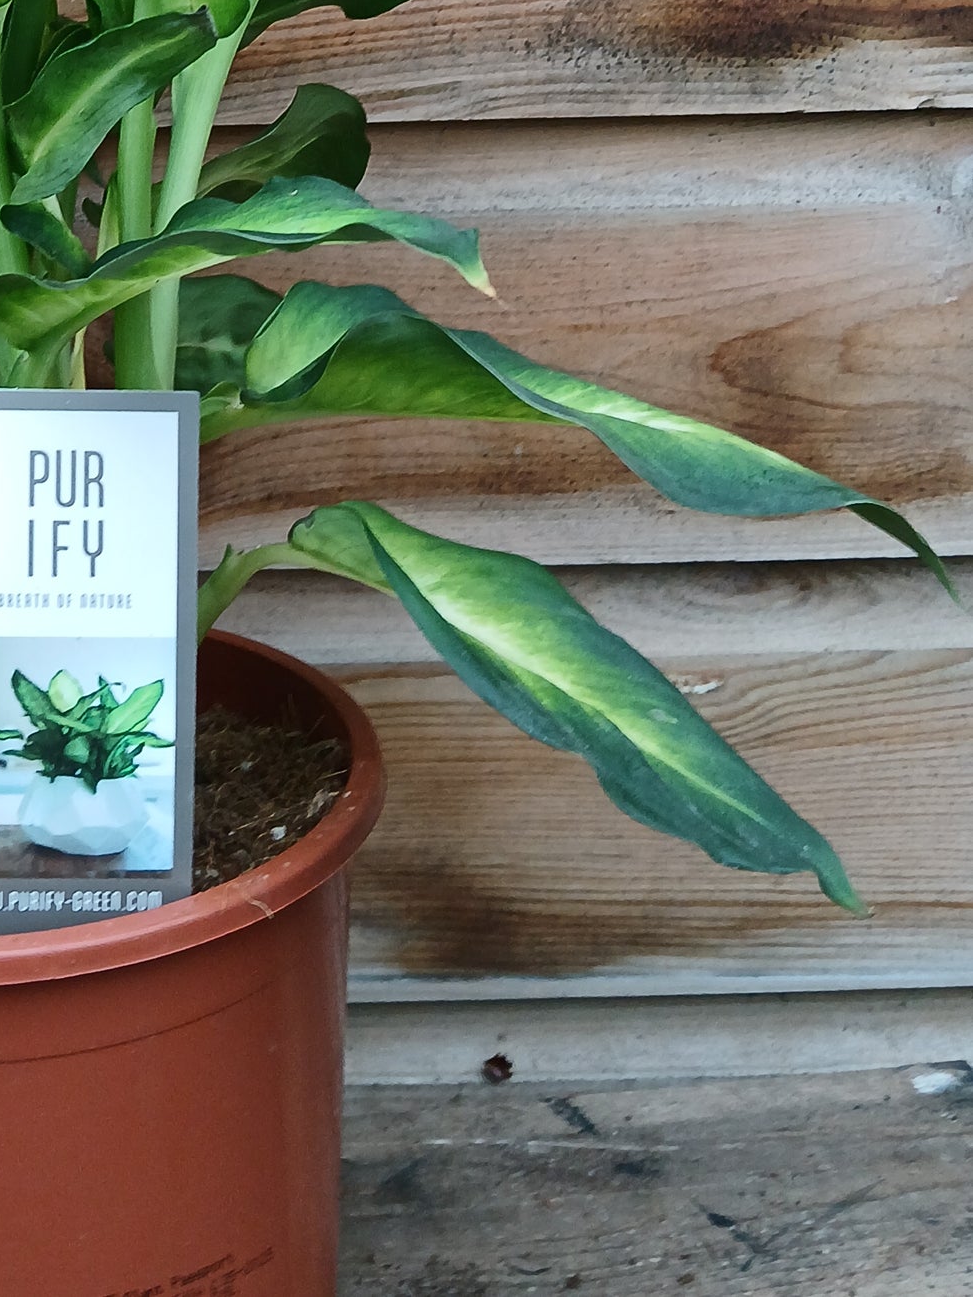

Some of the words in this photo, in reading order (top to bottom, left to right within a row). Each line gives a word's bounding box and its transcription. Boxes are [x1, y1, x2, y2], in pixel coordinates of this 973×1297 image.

[28, 449, 104, 508] PUR
[27, 519, 104, 578] IFY
[57, 593, 73, 608] OF
[80, 593, 133, 609] NATURE
